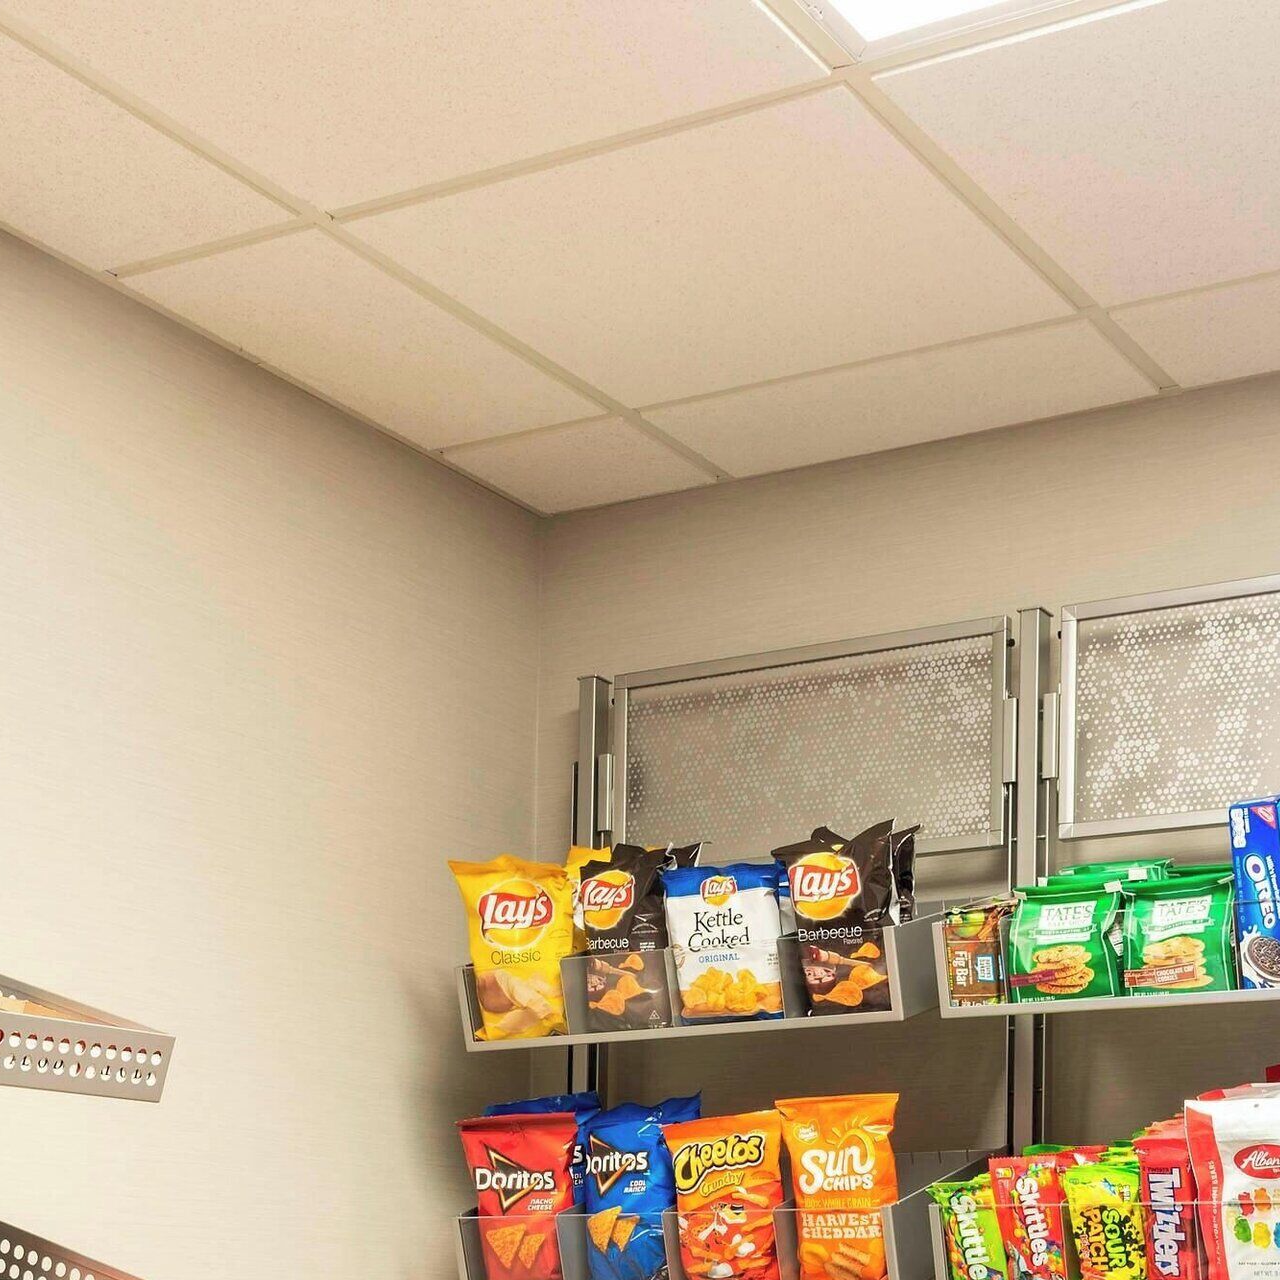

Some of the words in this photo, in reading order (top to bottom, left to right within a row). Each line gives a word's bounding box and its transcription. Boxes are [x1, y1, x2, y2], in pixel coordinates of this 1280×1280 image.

[790, 864, 862, 895] Lay's
[1243, 854, 1276, 929] OREO
[479, 895, 553, 930] Lay's
[1044, 905, 1093, 921] TATE'S
[1158, 899, 1209, 916] TATE'S
[694, 910, 744, 937] Kettle
[798, 924, 863, 942] Barbecue
[688, 932, 750, 953] Cooked
[491, 950, 541, 965] Classic
[698, 952, 740, 963] ORIGINAL
[674, 1134, 764, 1192] Cheetos
[800, 1144, 874, 1194] Sun
[476, 1166, 556, 1192] Doritos
[822, 1171, 875, 1190] CHIPS
[802, 1212, 882, 1227] HARVEST
[1016, 1177, 1049, 1267] Skittles
[1084, 1205, 1109, 1272] PATCH
[1102, 1208, 1126, 1268] SOUR
